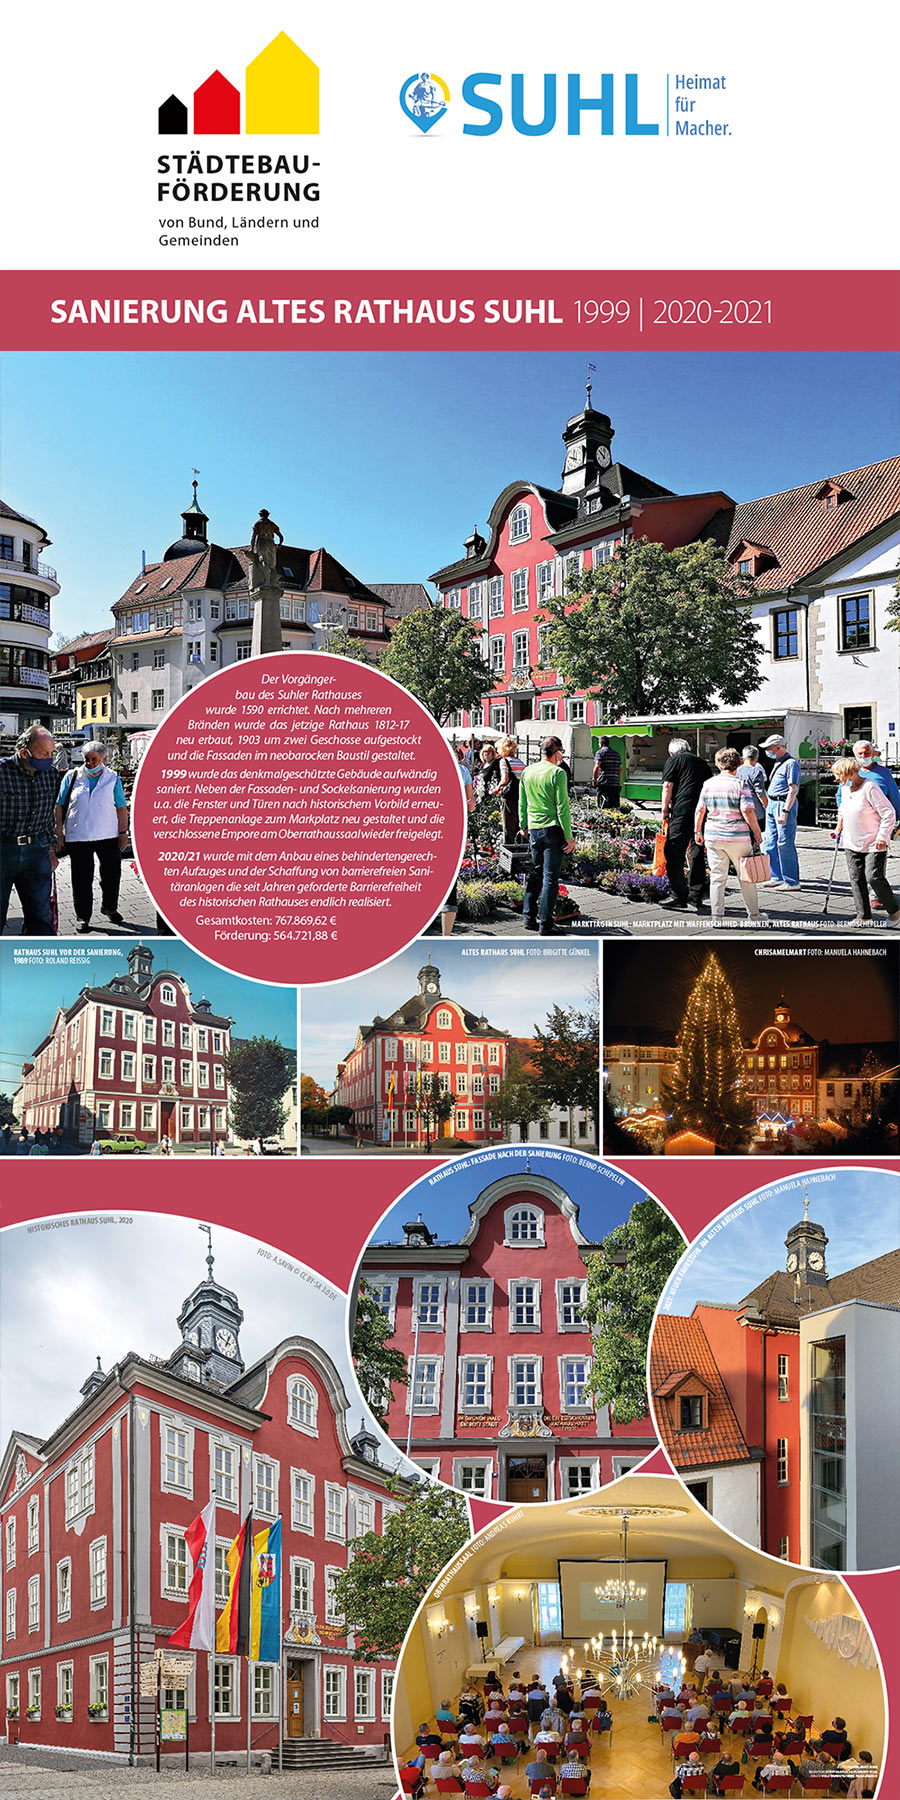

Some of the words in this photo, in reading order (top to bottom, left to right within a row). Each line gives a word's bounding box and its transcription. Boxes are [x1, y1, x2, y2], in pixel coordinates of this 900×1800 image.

[676, 74, 726, 90] Heimat
[462, 72, 660, 137] SUHL
[675, 96, 696, 112] für
[676, 120, 732, 136] Macher.
[157, 150, 320, 174] STÄDTEBAU-
[158, 178, 320, 202] FÖRDERUNG
[158, 219, 184, 228] von
[188, 216, 227, 230] Bund,
[232, 216, 288, 228] Ländern
[293, 216, 319, 228] und
[158, 234, 238, 246] Gemeinden
[51, 299, 228, 324] SANIERUNG
[236, 299, 325, 324] ALTES
[334, 299, 475, 324] RATHAUS
[484, 299, 563, 324] SUHL
[574, 300, 630, 324] 1999
[653, 300, 771, 324] 2020-2021
[282, 674, 336, 686] Vorgänger-
[235, 690, 256, 700] bau
[278, 689, 309, 700] Suhler
[311, 689, 362, 700] Rathauses
[206, 704, 237, 715] wurde
[242, 704, 264, 715] 1590
[268, 704, 310, 715] errichtet.
[314, 704, 340, 714] Nach
[344, 704, 392, 715] mehreren
[188, 719, 230, 730] Bränden
[234, 720, 266, 730] wurde
[290, 720, 325, 732] jetzige
[328, 719, 369, 730] Rathaus
[376, 720, 410, 730] 1812-17
[176, 736, 195, 745] neu
[198, 734, 233, 746] erbaut,
[238, 735, 261, 745] 1903
[283, 734, 308, 745] zwei
[310, 734, 361, 745] Geschosse
[363, 734, 422, 747] aufgestockt
[167, 750, 188, 760] und
[206, 750, 252, 760] Fassaden
[270, 750, 334, 760] neobarocken
[336, 750, 370, 760] Baustil
[371, 750, 416, 763] gestaltet.
[162, 769, 187, 779] 1999
[188, 769, 220, 779] wurde
[239, 769, 336, 782] denkmalgeschützte
[336, 768, 382, 779] Gebäude
[382, 768, 437, 782] aufwändig
[156, 784, 192, 794] saniert.
[194, 784, 227, 794] Neben
[247, 784, 297, 794] Fassaden-
[299, 784, 320, 794] und
[321, 783, 402, 796] Sockelsanierung
[403, 784, 441, 794] wurden
[192, 798, 228, 809] Fenster
[230, 798, 250, 809] und
[252, 798, 280, 809] Türen
[282, 799, 308, 809] nach
[310, 798, 372, 809] historischem
[374, 798, 410, 809] Vorbild
[411, 801, 443, 809] erneu-
[189, 814, 263, 826] Treppenanlage
[264, 816, 286, 824] zum
[288, 814, 340, 826] Markplatz
[341, 816, 360, 824] neu
[362, 814, 406, 826] gestaltet
[407, 814, 428, 824] und
[153, 829, 220, 839] verschlossene
[221, 828, 260, 841] Empore
[278, 828, 361, 839] Oberrathaussaal
[361, 828, 395, 839] wieder
[396, 828, 443, 842] freigelegt.
[158, 851, 200, 861] 2020/21
[203, 851, 235, 861] wurde
[254, 851, 278, 861] dem
[278, 851, 312, 861] Anbau
[314, 851, 339, 862] eines
[341, 851, 437, 864] behindertengerech-
[180, 866, 226, 878] Aufzuges
[228, 866, 249, 876] und
[268, 866, 318, 878] Schaffung
[320, 868, 339, 876] von
[341, 866, 406, 876] barrierefreien
[408, 866, 433, 876] Sani-
[170, 882, 225, 894] täranlagen
[261, 882, 296, 892] Jahren
[296, 881, 348, 894] geforderte
[350, 881, 422, 892] Barrierefreiheit
[198, 896, 256, 907] historischen
[258, 896, 308, 907] Rathauses
[310, 896, 346, 907] endlich
[348, 896, 392, 907] realisiert.
[196, 915, 272, 926] Gesamtkosten:
[275, 916, 327, 926] 767.869,62
[214, 930, 271, 943] Förderung:
[274, 930, 328, 941] 564.721,88
